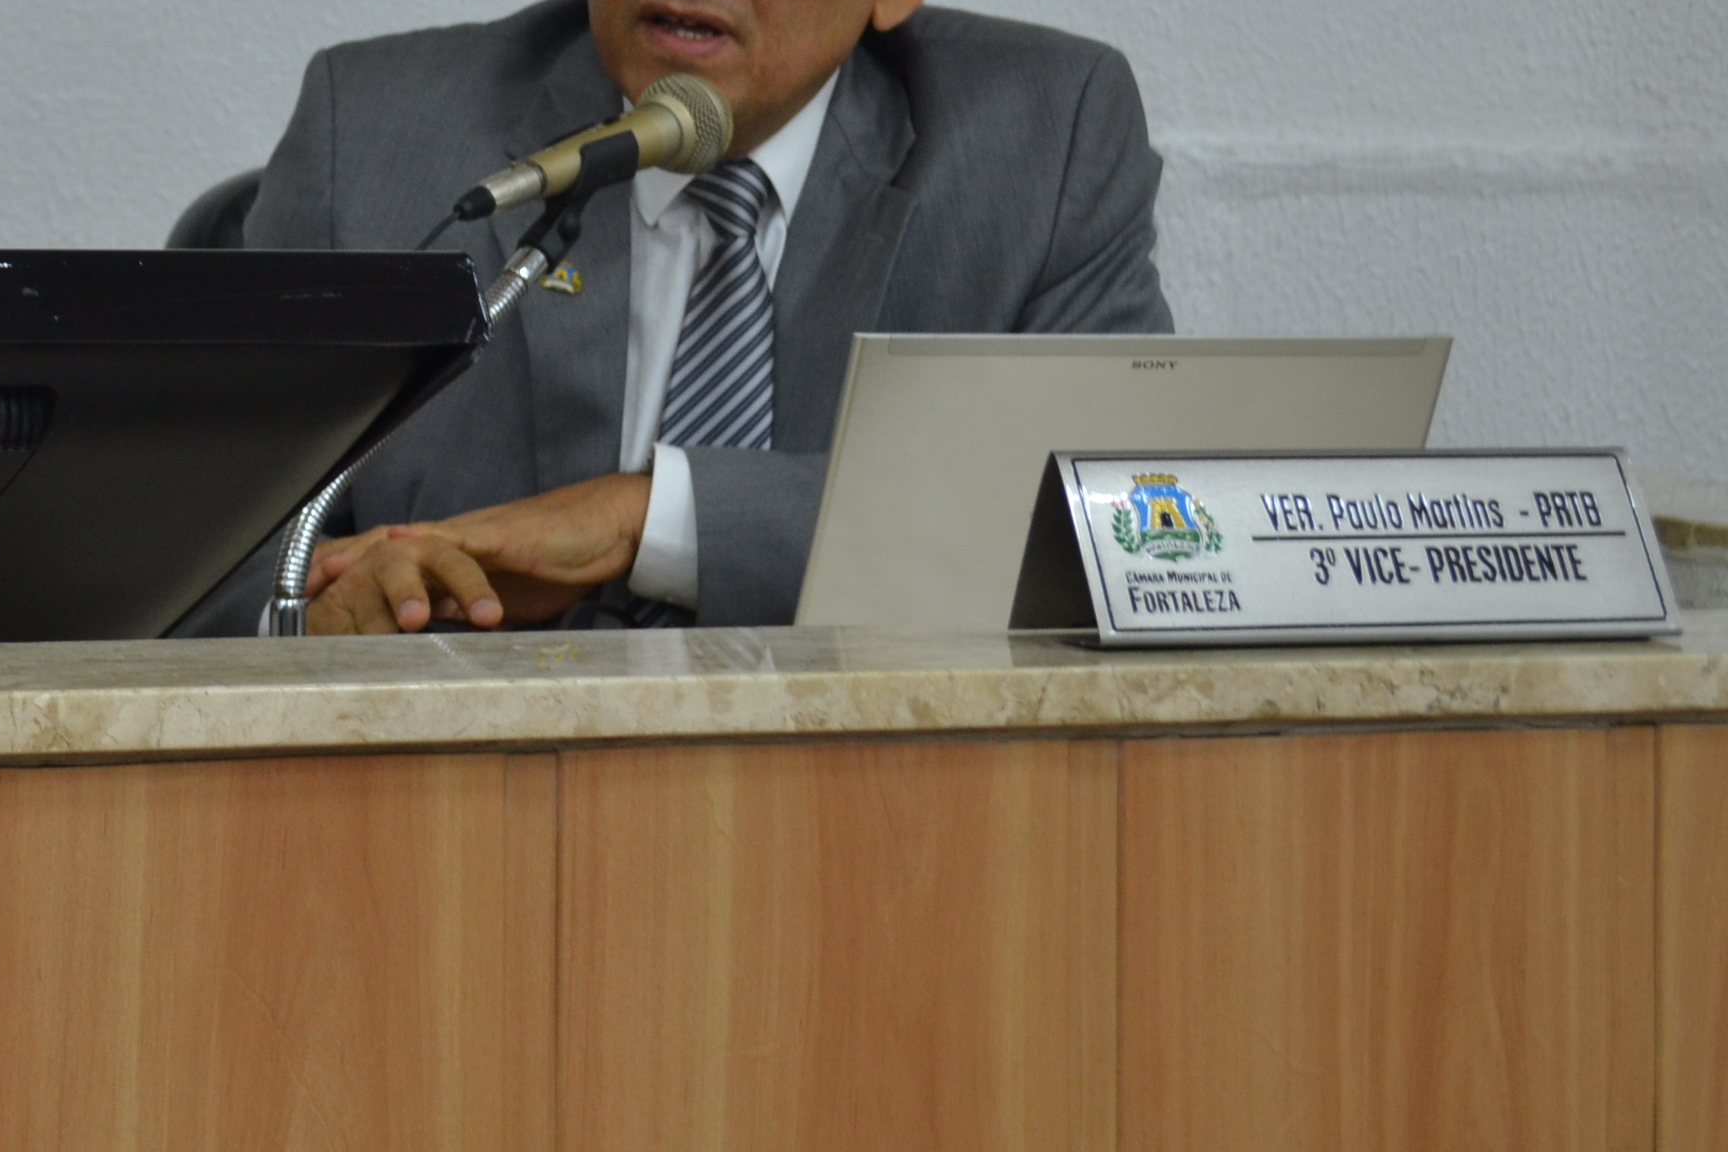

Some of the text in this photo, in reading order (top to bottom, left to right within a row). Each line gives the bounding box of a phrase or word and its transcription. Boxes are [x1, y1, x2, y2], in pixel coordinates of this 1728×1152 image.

[1132, 360, 1178, 369] SONY
[1260, 493, 1323, 531] VER.
[1326, 493, 1404, 530] Paulo
[1406, 492, 1505, 530] Martins
[1533, 491, 1603, 528] PRTB
[1425, 543, 1588, 583] PRESIDENTE
[1127, 586, 1242, 615] FORTALEZA
